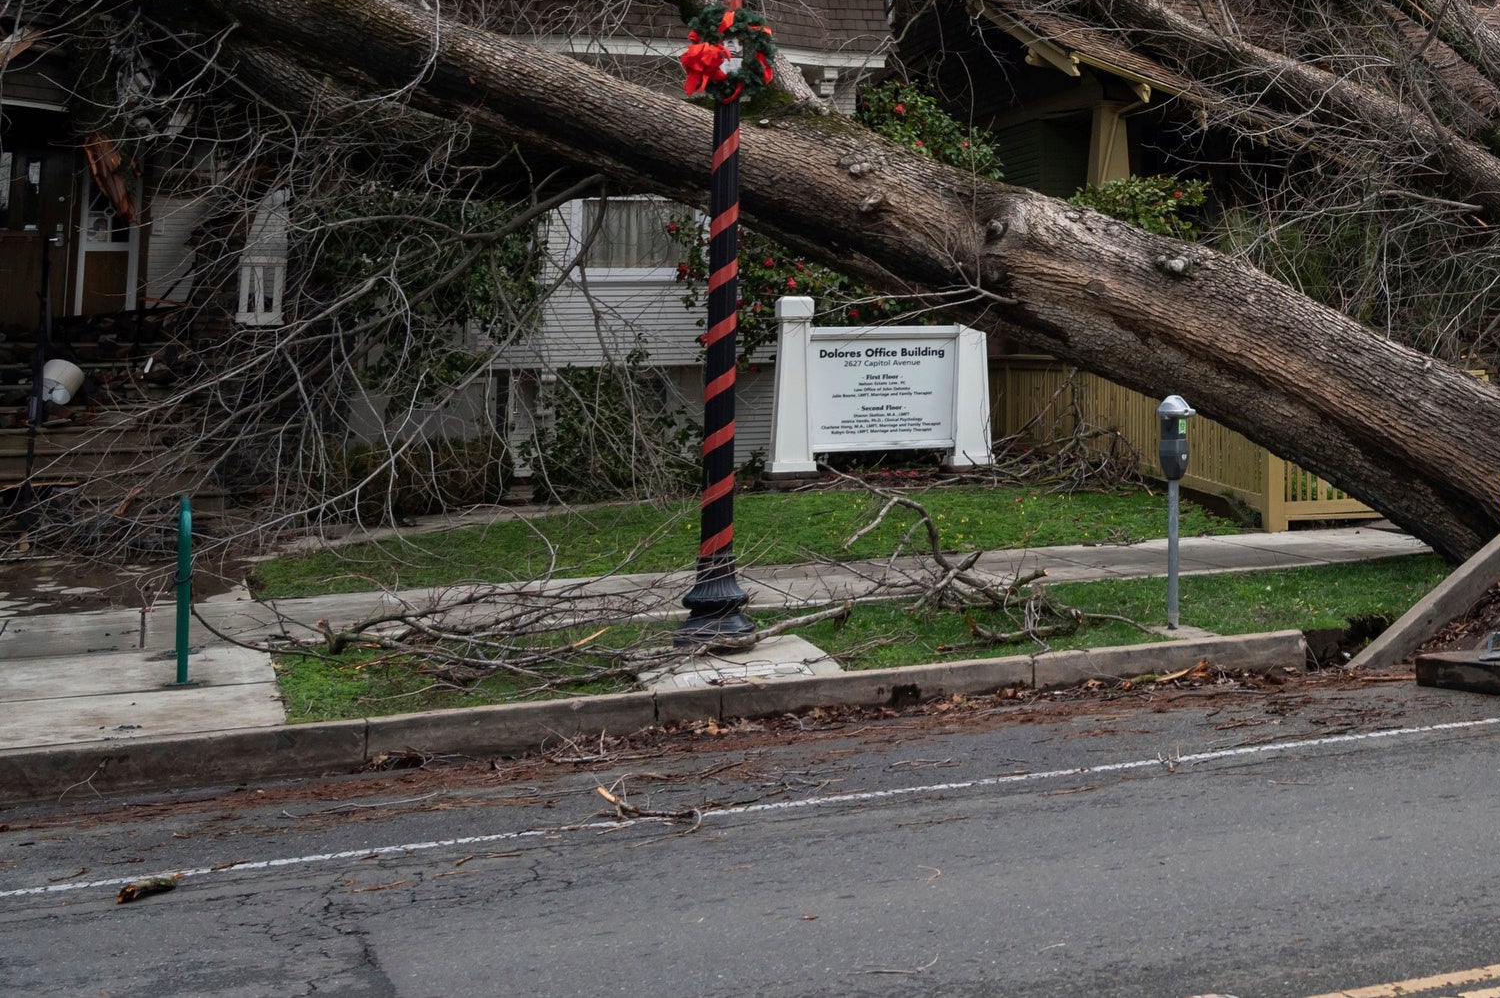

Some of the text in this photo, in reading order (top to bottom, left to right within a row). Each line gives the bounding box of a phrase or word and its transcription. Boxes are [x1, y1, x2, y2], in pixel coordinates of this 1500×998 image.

[819, 347, 945, 358] Dolores Office Building
[864, 359, 891, 368] Capitol
